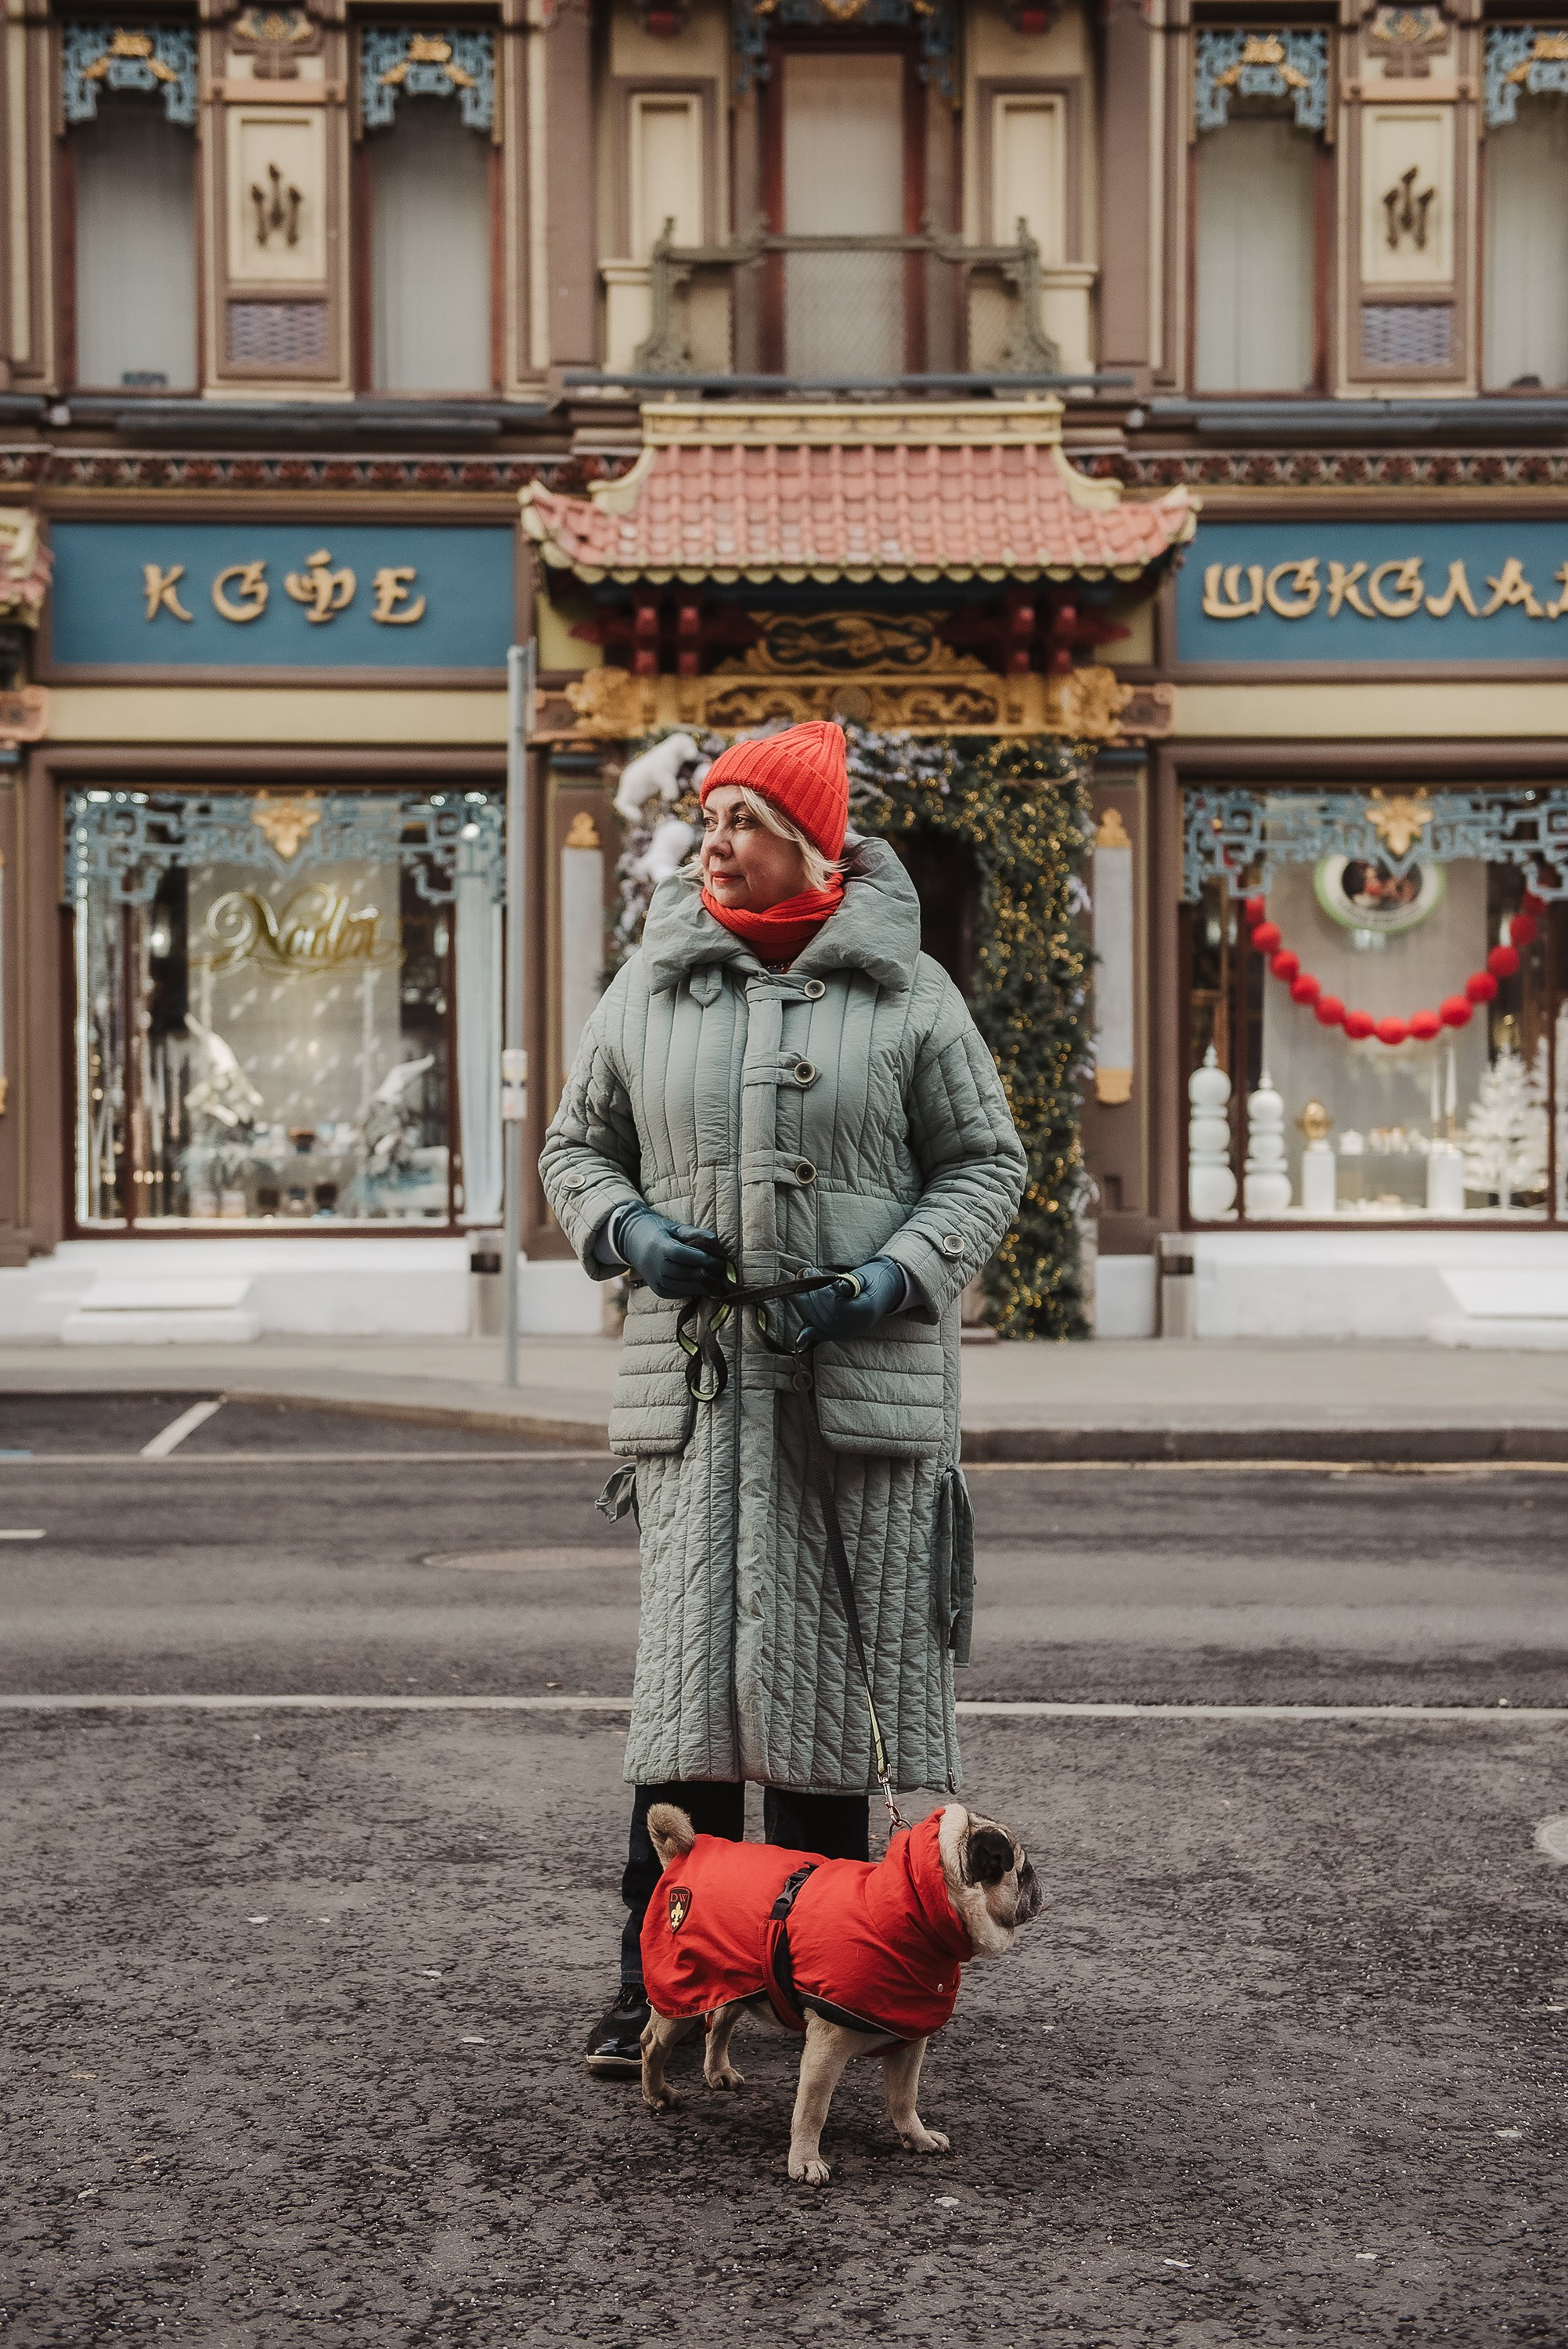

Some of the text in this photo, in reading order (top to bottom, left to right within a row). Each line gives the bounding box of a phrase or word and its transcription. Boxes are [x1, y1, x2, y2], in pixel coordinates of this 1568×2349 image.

[143, 548, 427, 623] КОФЕ
[1202, 557, 1568, 619] ШОКОЛА
[670, 1893, 688, 1903] DW
